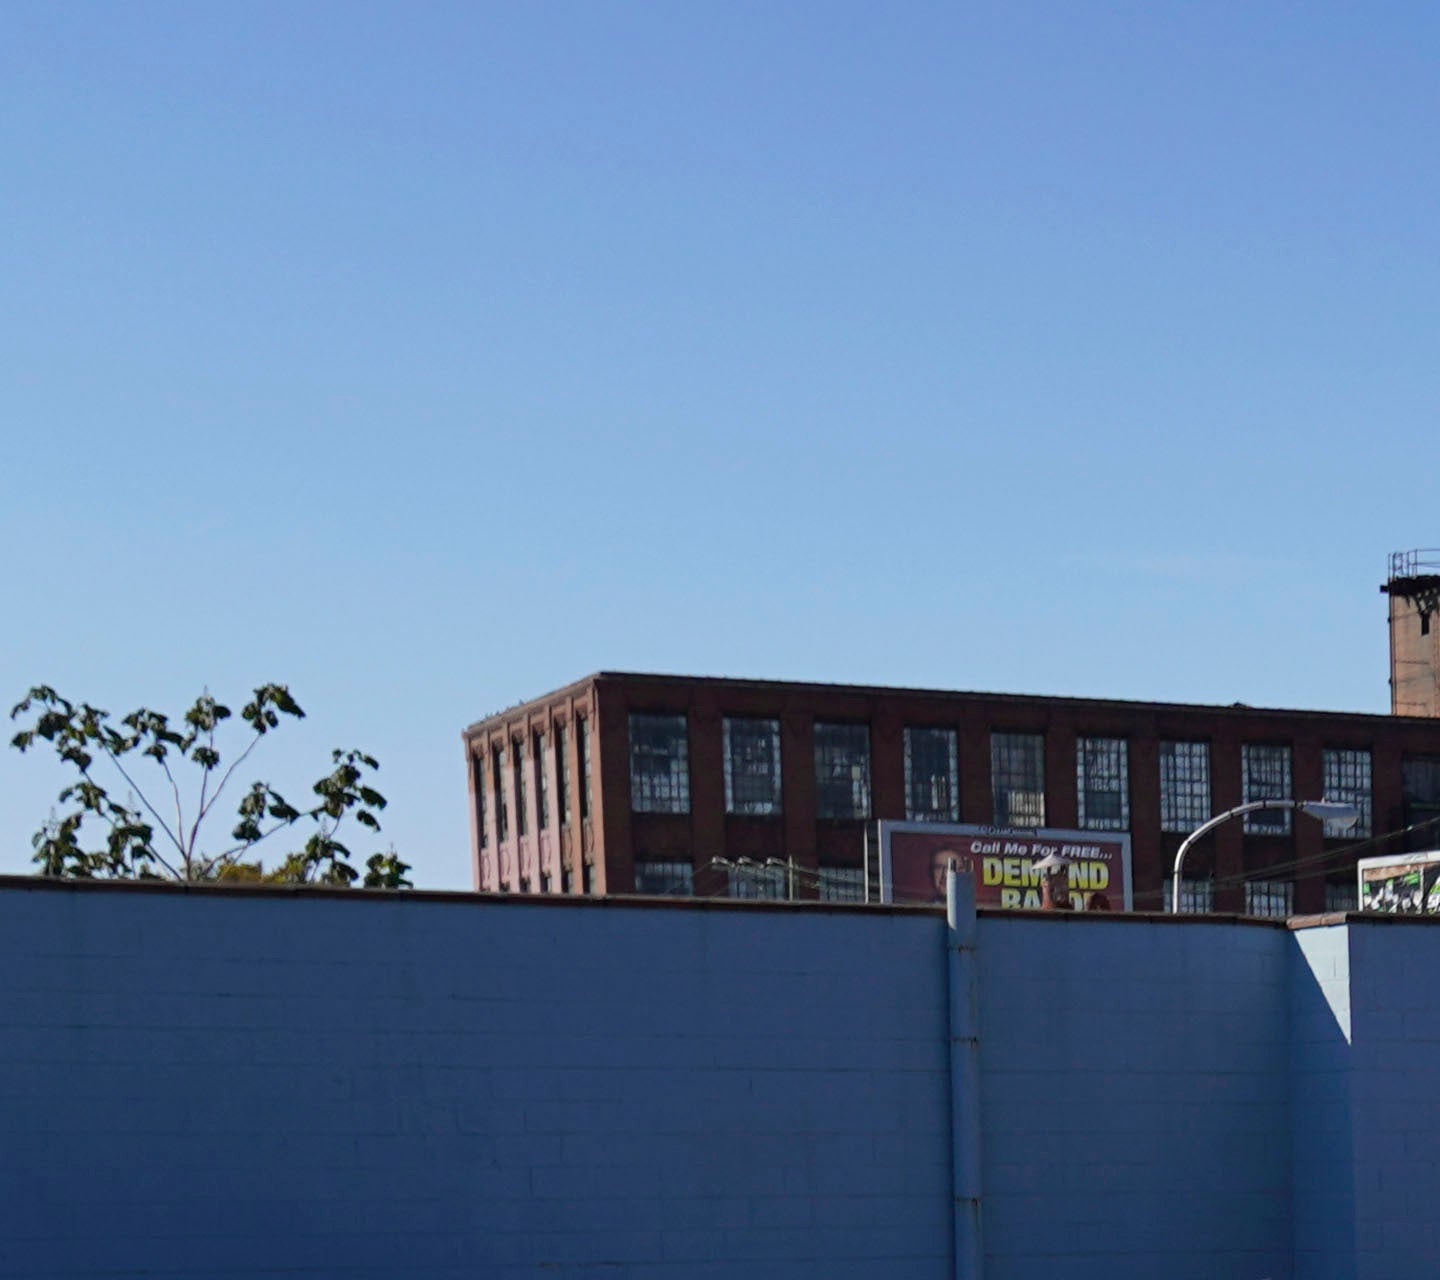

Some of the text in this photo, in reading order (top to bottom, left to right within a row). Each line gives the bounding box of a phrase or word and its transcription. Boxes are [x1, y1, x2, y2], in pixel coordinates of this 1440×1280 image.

[971, 841, 1000, 853] Call
[1004, 843, 1028, 854] Me
[983, 857, 1109, 889] DEMND
